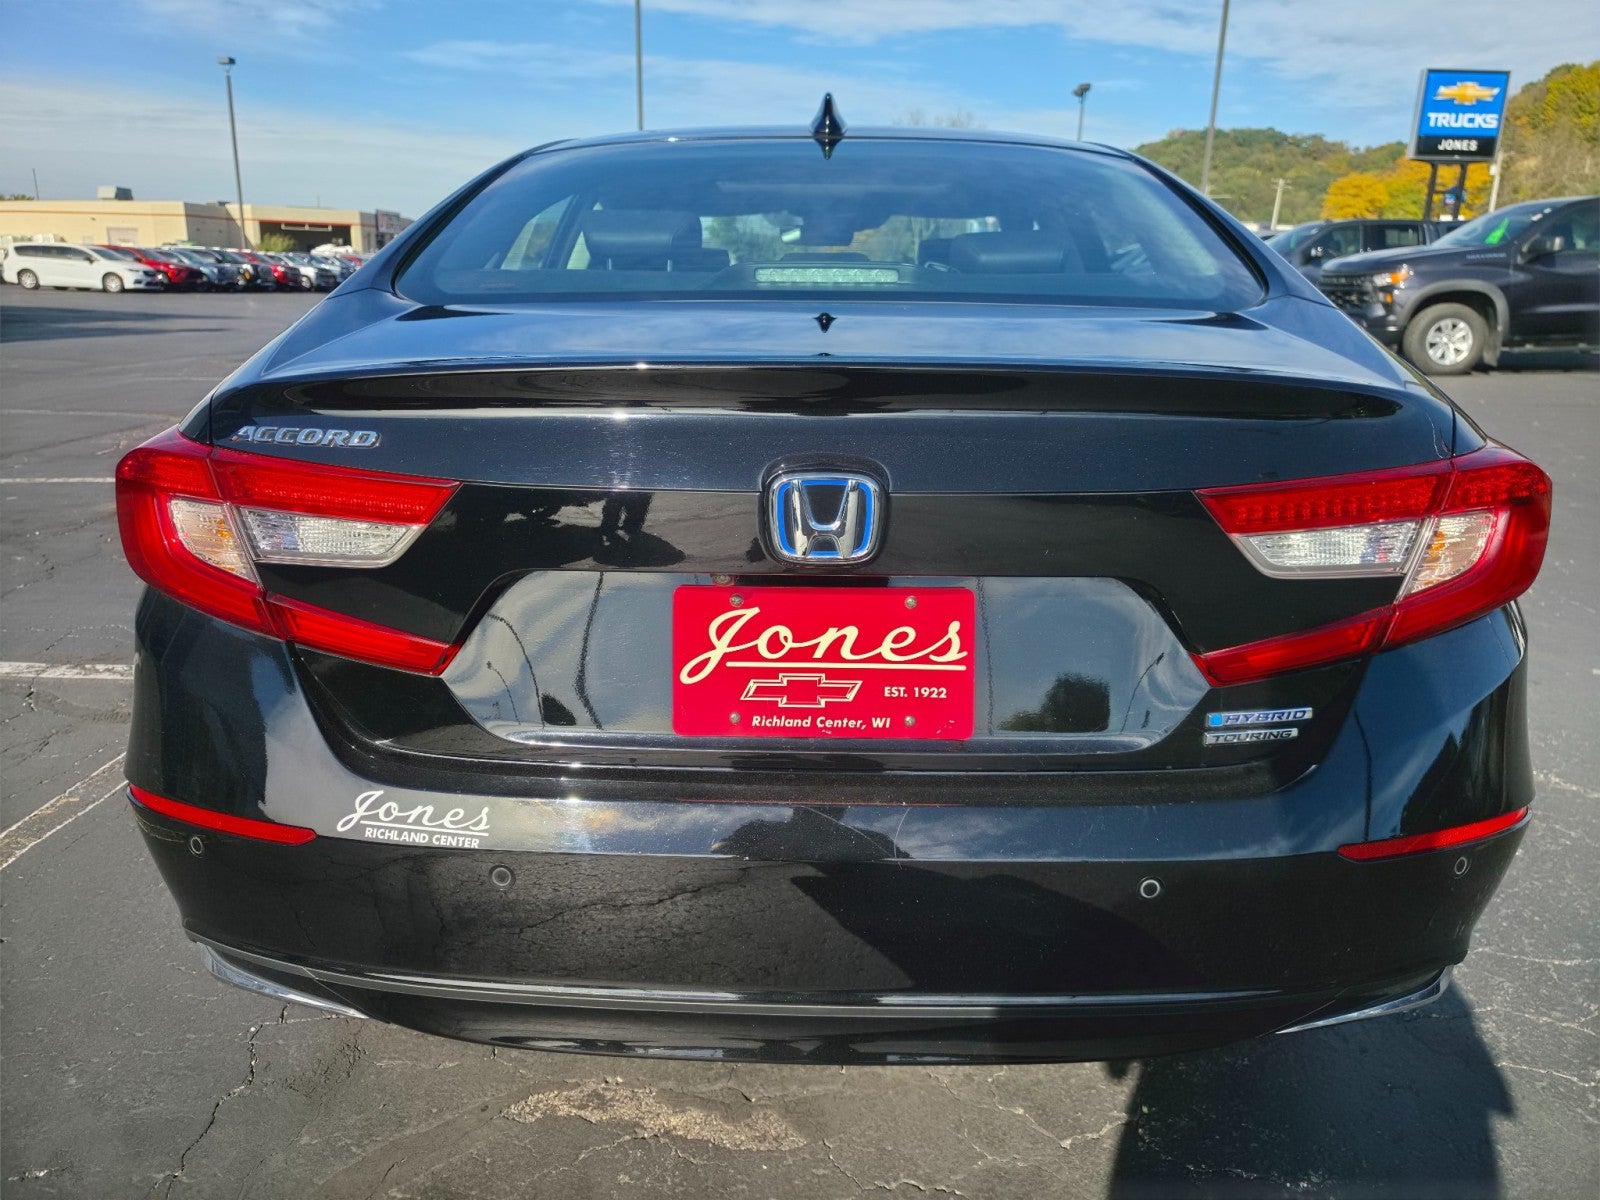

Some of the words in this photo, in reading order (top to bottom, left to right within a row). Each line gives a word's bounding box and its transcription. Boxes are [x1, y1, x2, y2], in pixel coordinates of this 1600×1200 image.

[1427, 112, 1499, 128] TRUCKS
[1437, 138, 1478, 151] JONES
[231, 425, 381, 448] ACCORD
[679, 606, 968, 684] Jones
[884, 686, 908, 698] EST.
[913, 687, 947, 699] 1922
[752, 715, 811, 727] Richland
[816, 716, 867, 729] Center,
[871, 717, 891, 729] WI
[1225, 709, 1307, 724] HYBRID
[1212, 729, 1292, 742] TOURING
[336, 790, 490, 832] Jones
[365, 827, 429, 844] RICHLAND
[432, 834, 480, 849] CENTER
